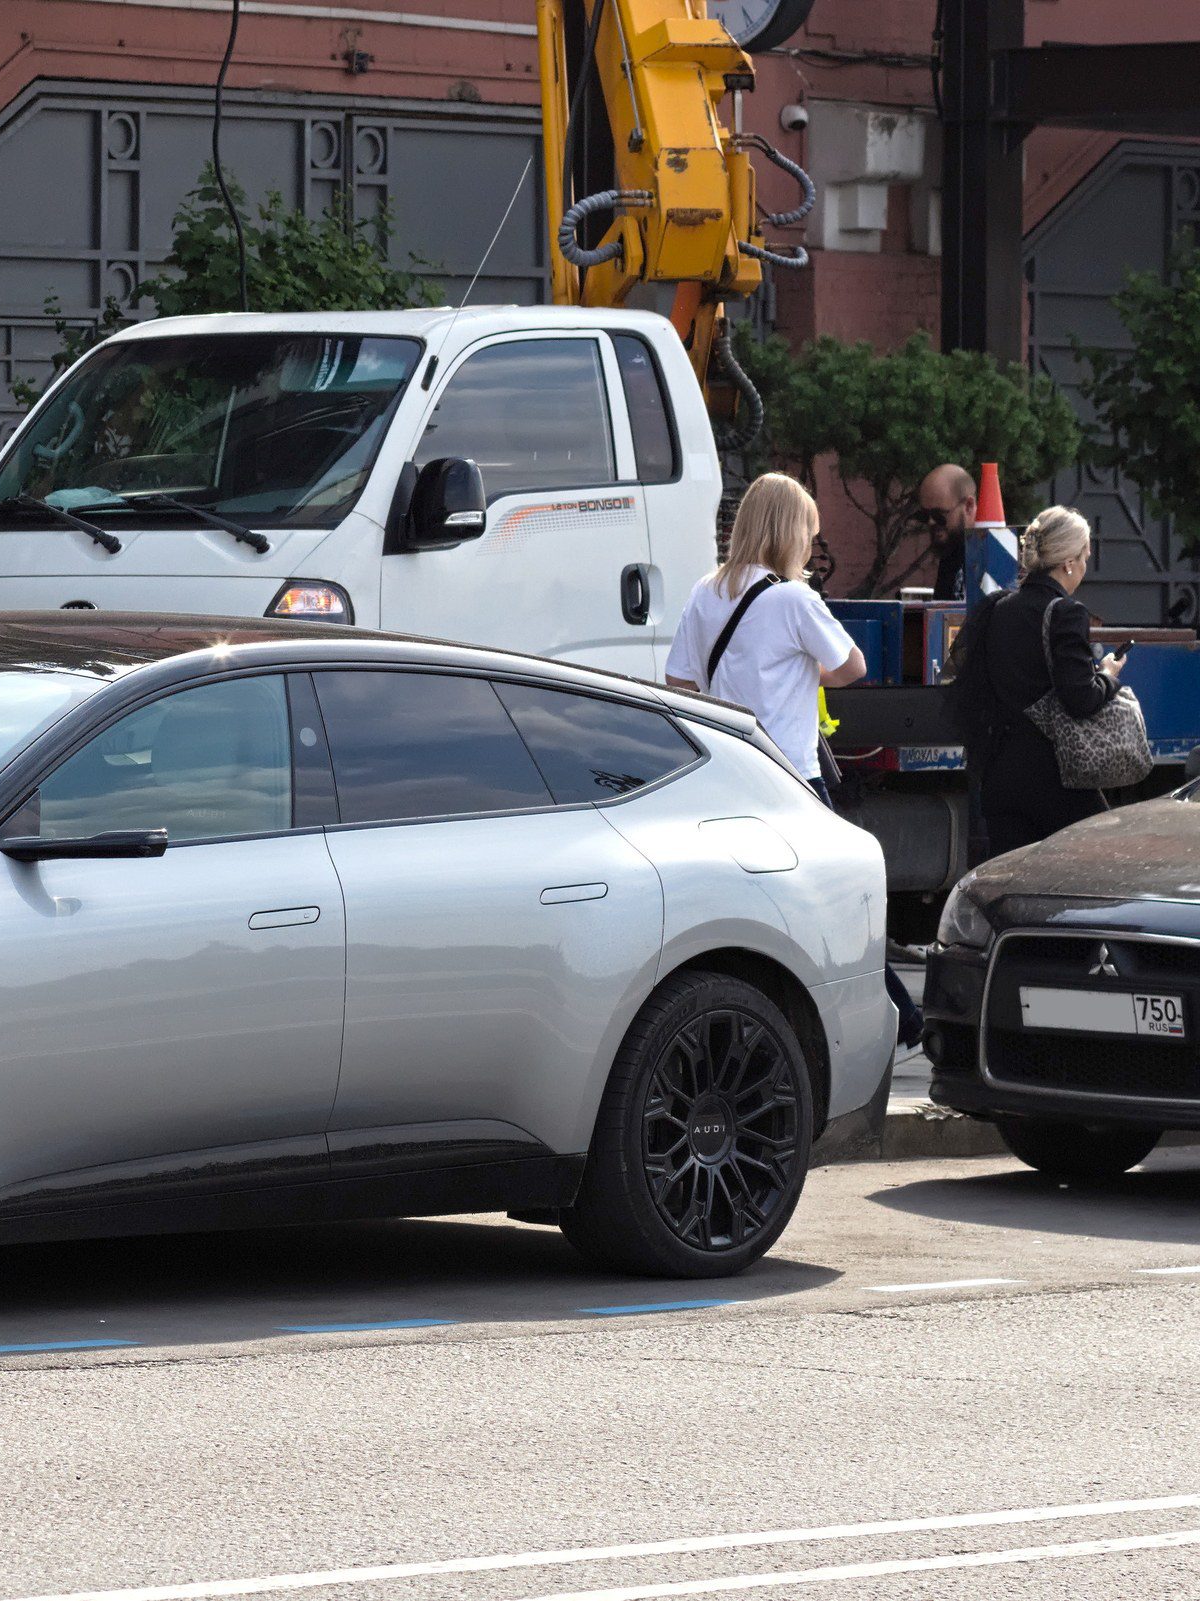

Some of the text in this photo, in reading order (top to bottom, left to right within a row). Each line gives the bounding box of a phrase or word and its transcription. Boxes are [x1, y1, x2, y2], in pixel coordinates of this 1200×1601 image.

[579, 498, 621, 512] BONGO
[1136, 997, 1176, 1022] 750
[1149, 1022, 1168, 1032] RUS
[693, 1125, 725, 1134] AUDI
